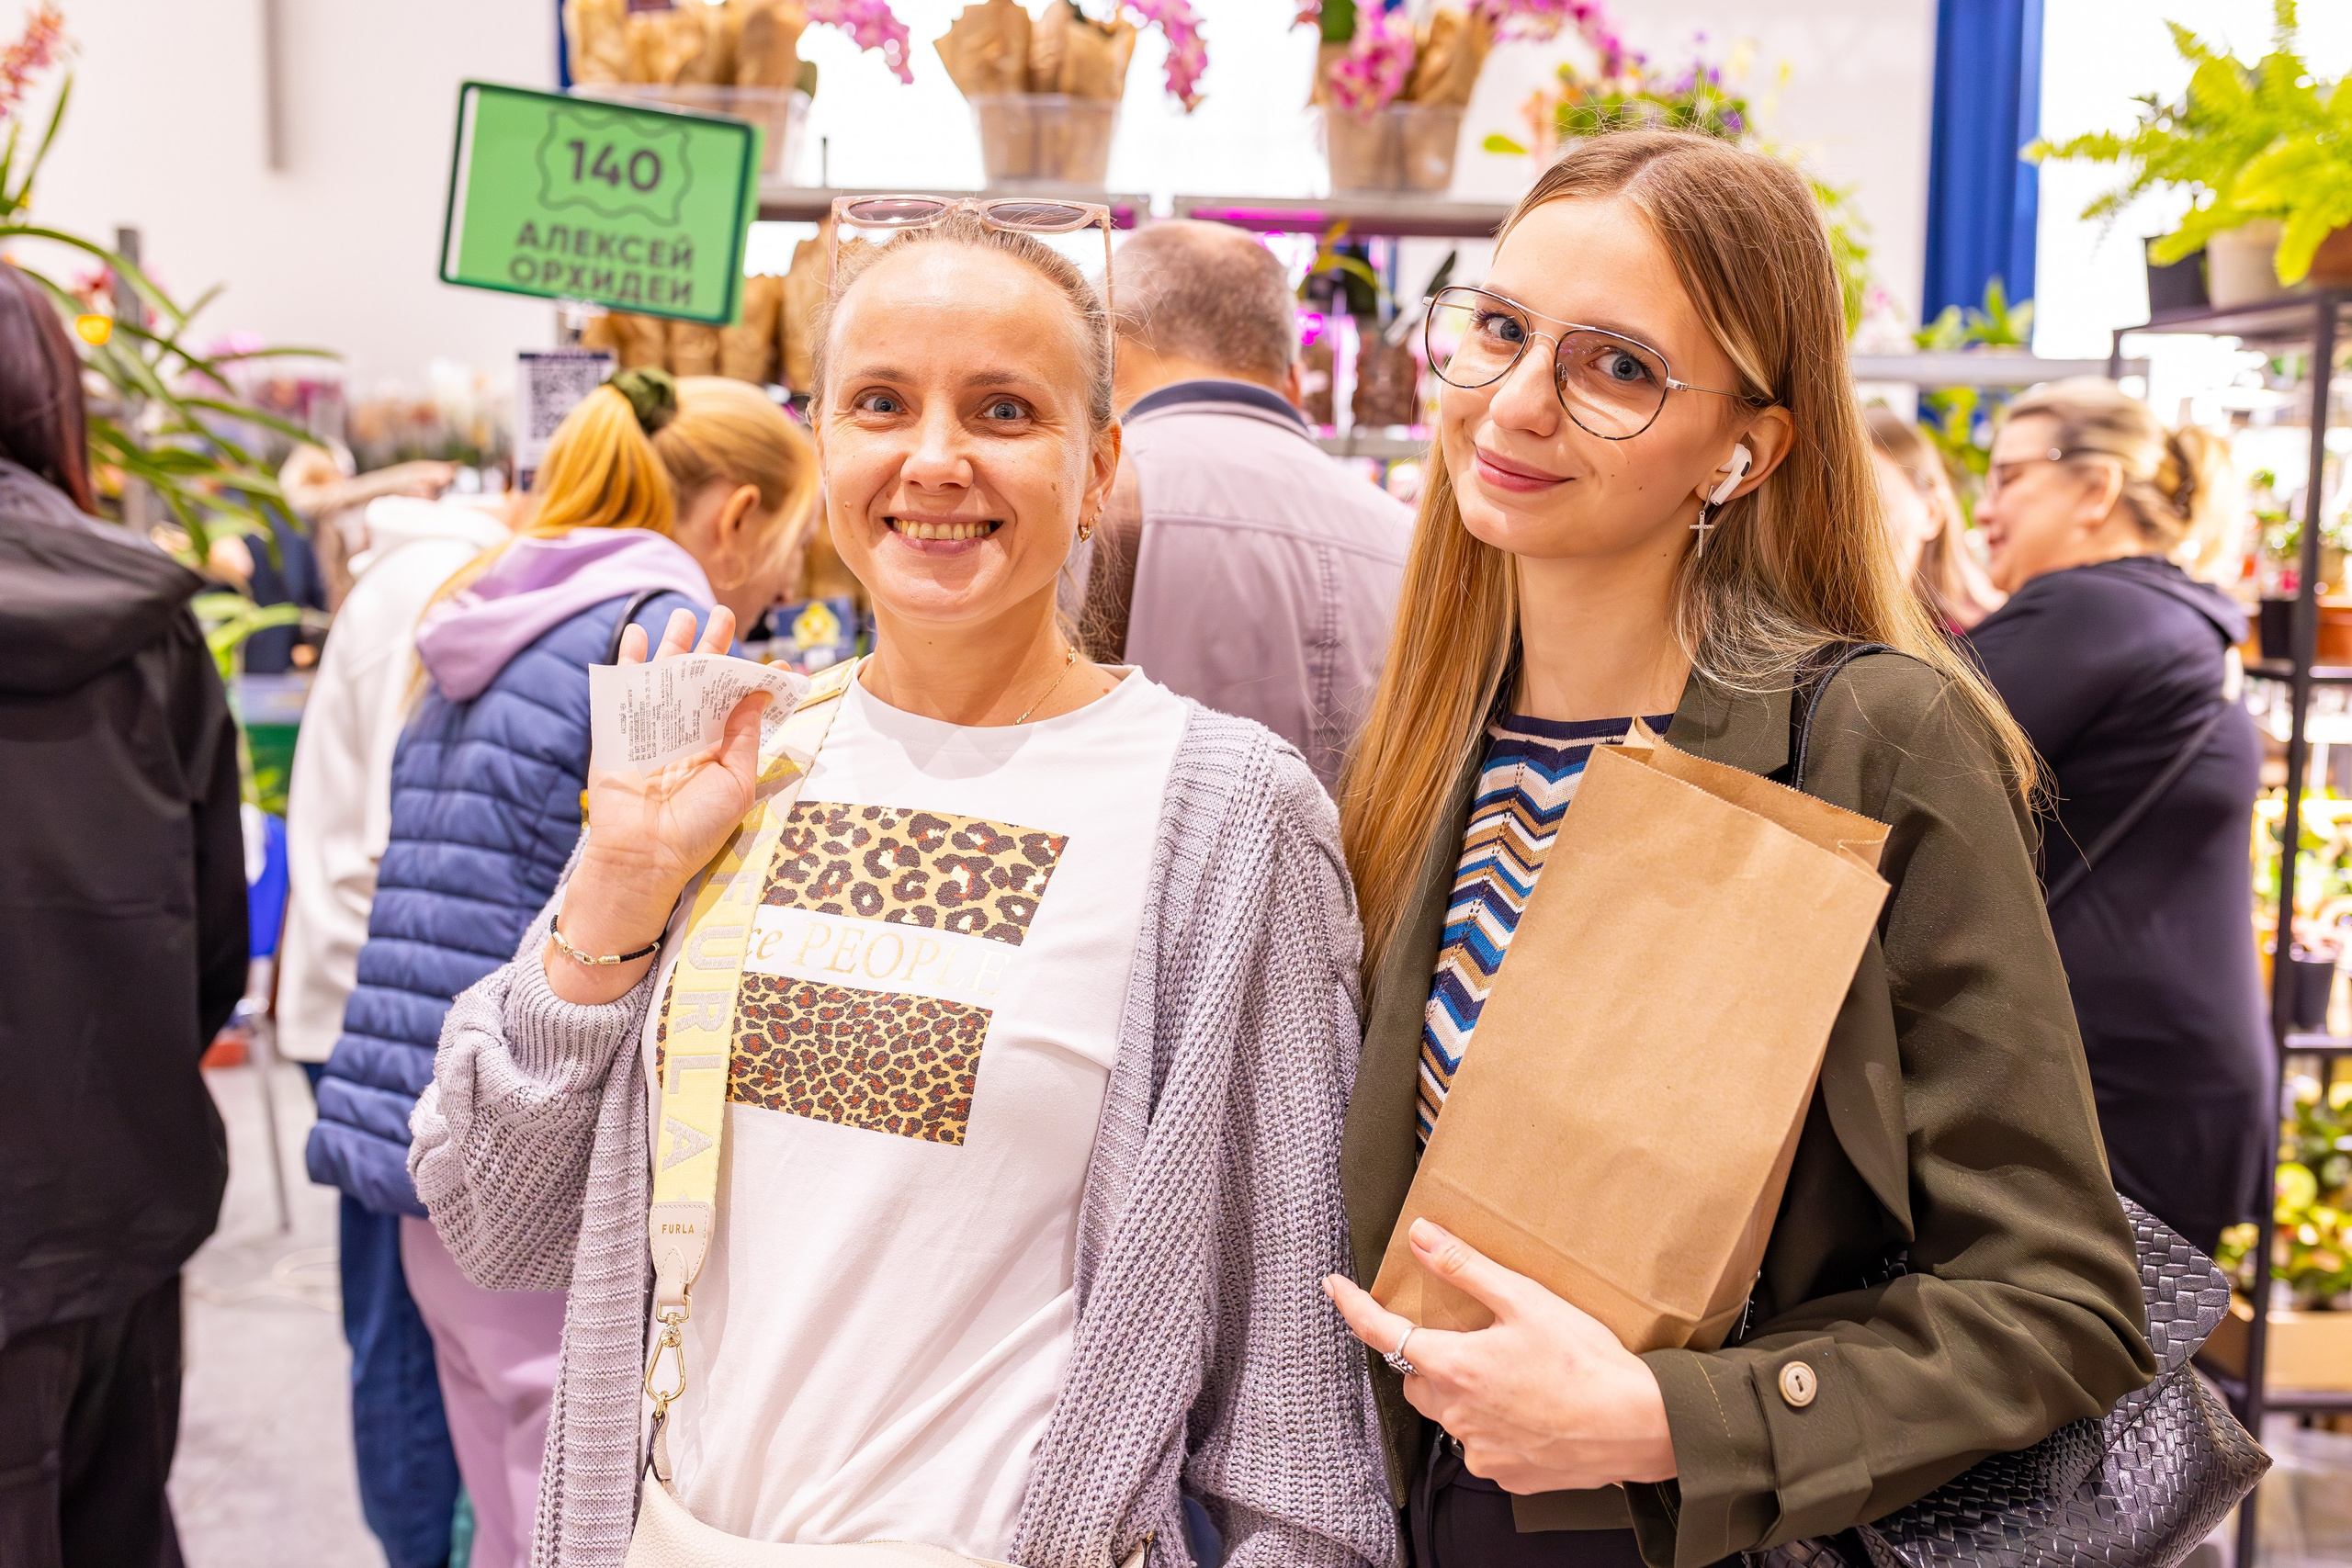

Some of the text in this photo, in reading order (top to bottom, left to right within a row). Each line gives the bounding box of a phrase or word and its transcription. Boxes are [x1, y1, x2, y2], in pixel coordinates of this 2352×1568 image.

[565, 139, 662, 193] 140
[515, 220, 694, 273] АЛЕКСЕЙ
[508, 254, 694, 307] ОРХИДЕИ
[789, 920, 1012, 998] PEOPLE
[662, 870, 761, 1173] FURLA
[661, 1223, 695, 1235] FURLA
